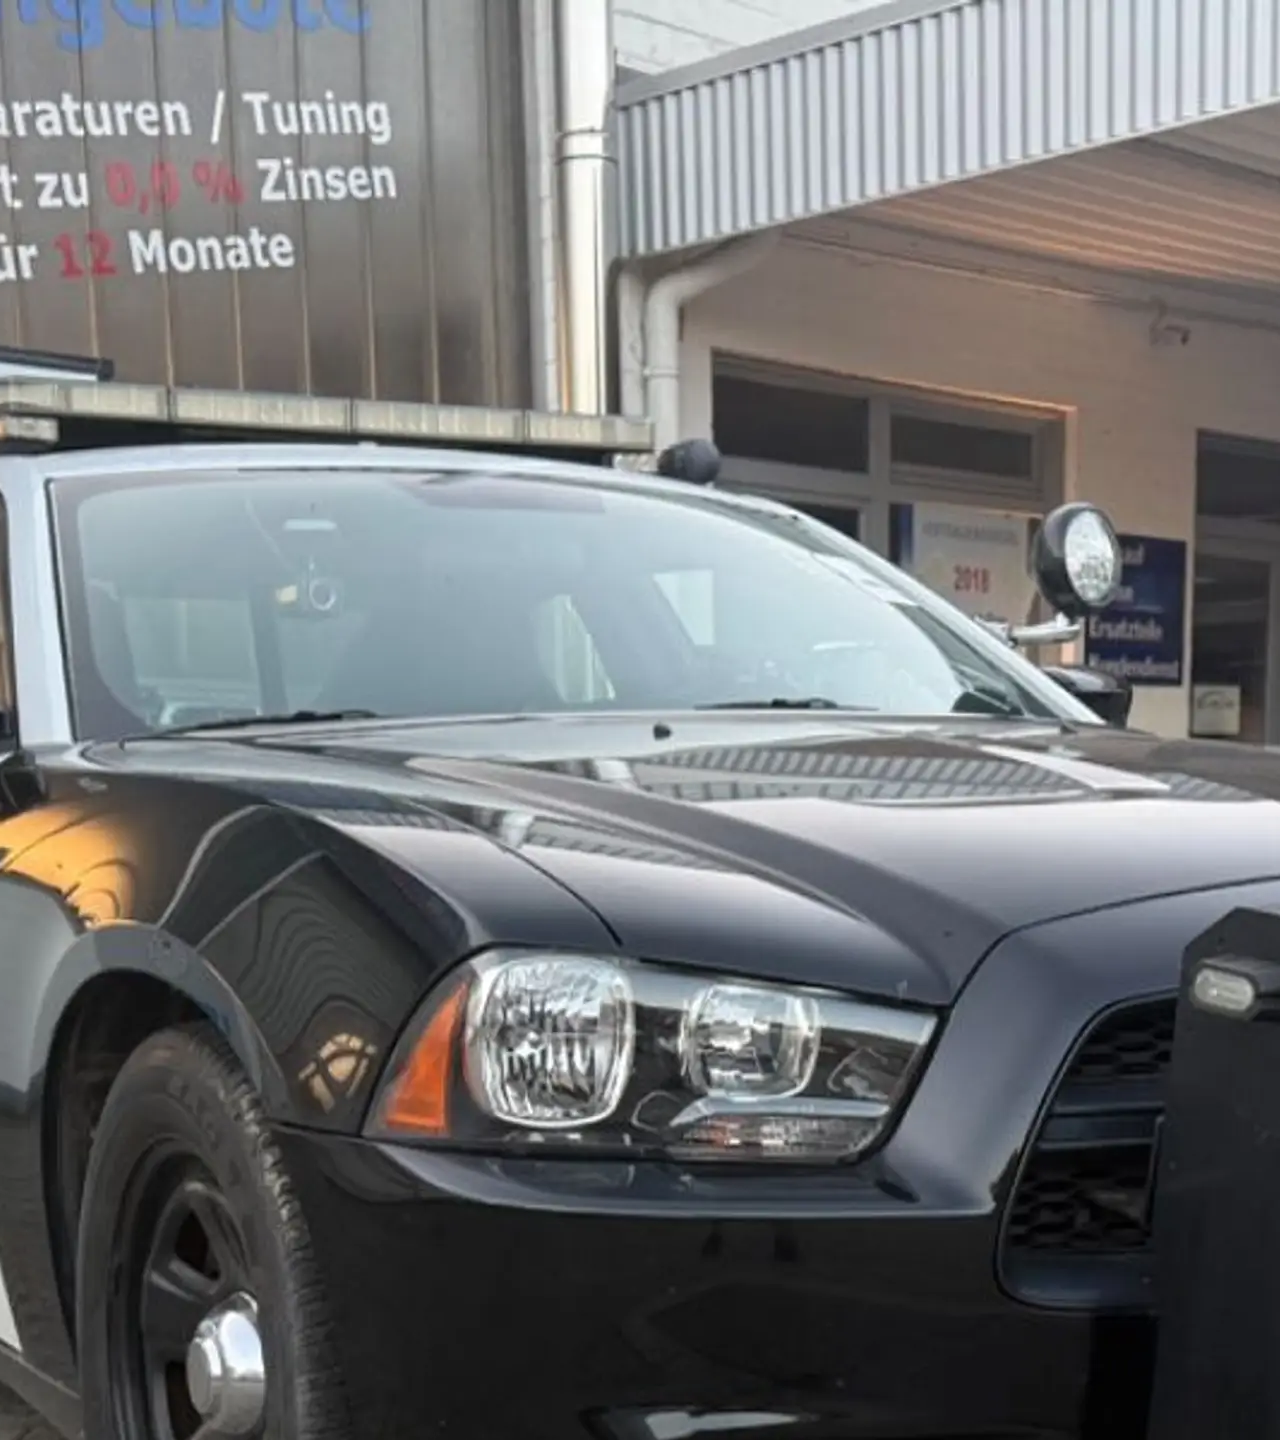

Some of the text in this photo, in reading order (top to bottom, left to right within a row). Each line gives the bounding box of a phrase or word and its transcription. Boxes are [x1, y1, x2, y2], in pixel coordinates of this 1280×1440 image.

[211, 90, 224, 144] /
[241, 90, 392, 144] Tuning
[35, 172, 89, 208] zu
[105, 158, 181, 215] 0,0
[192, 160, 245, 207] %
[256, 158, 397, 202] Zinsen
[53, 228, 116, 279] 12
[128, 226, 295, 274] Monate
